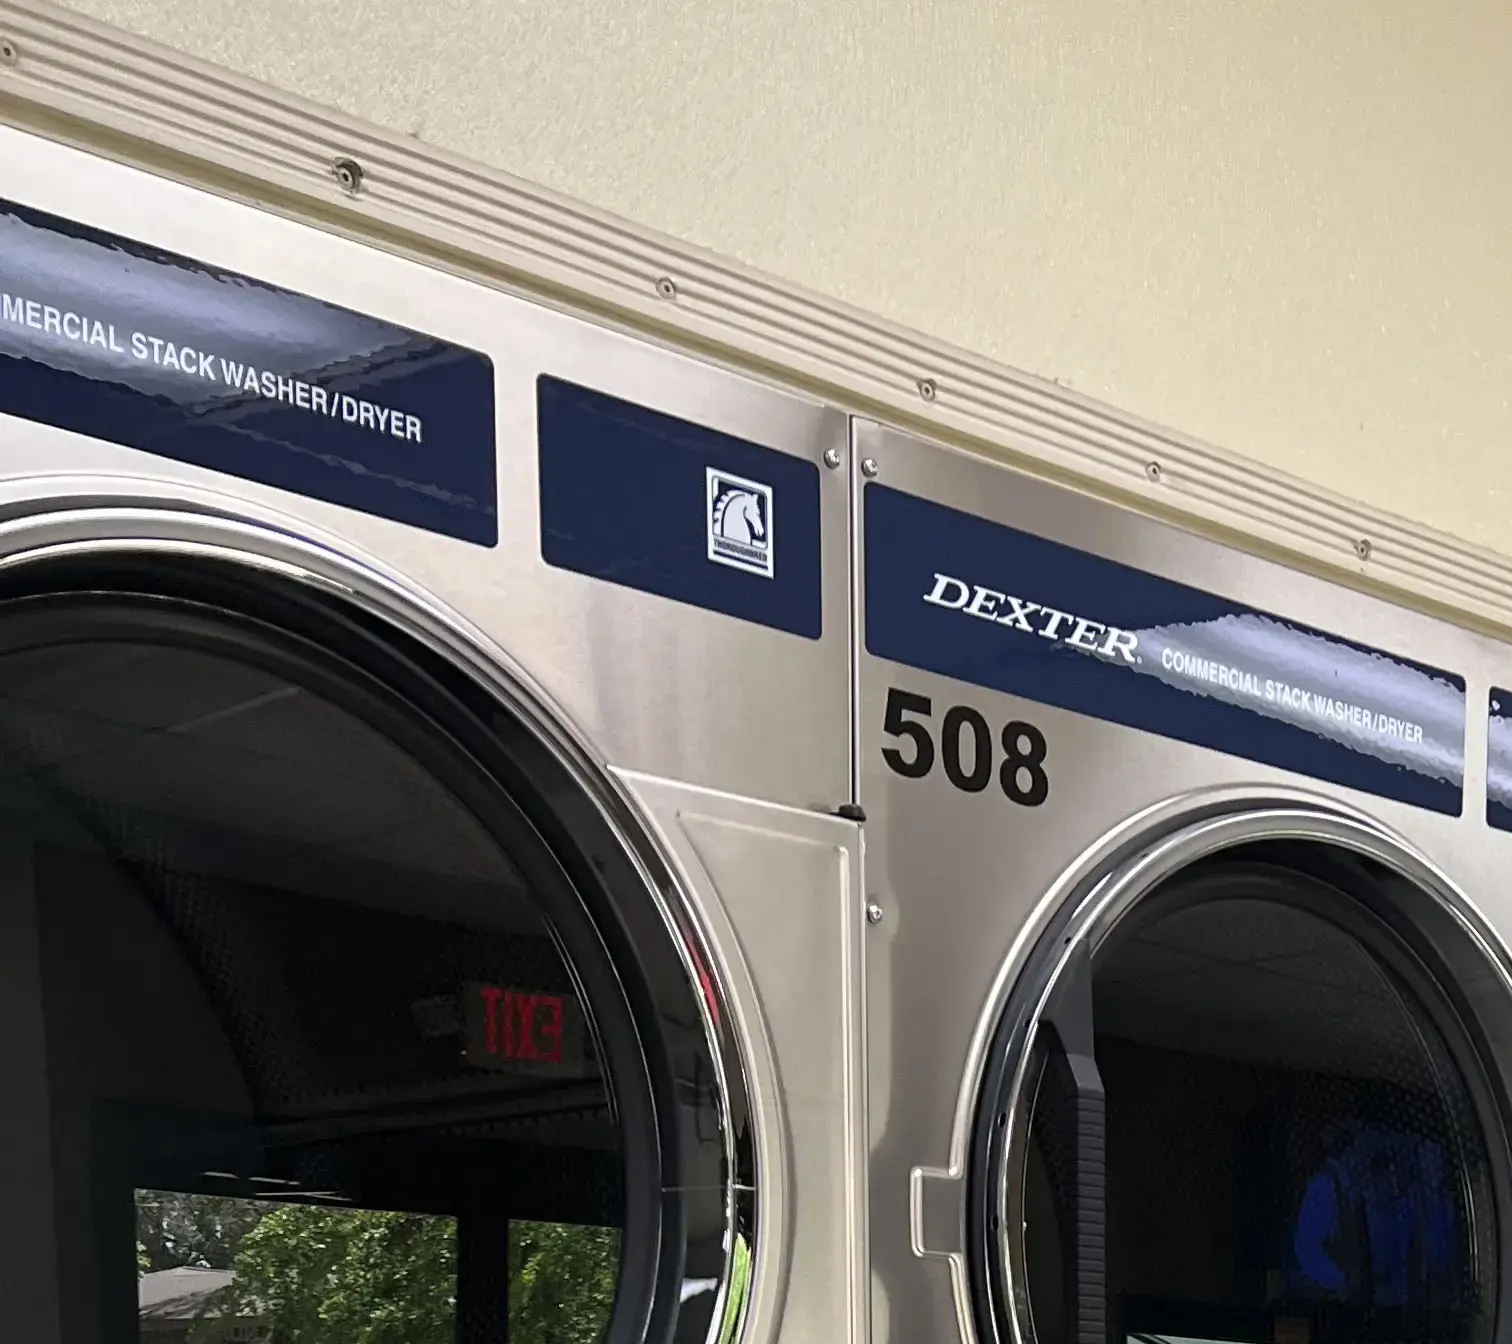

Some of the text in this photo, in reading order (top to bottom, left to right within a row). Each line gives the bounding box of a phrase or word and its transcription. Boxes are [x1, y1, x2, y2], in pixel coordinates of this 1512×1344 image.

[0, 293, 422, 443] MERCIAL STACK WASHER/DRYER
[923, 573, 1422, 744] DEXTER COMMERCIAL STACK WASHER/DRYER
[881, 687, 1048, 807] 508
